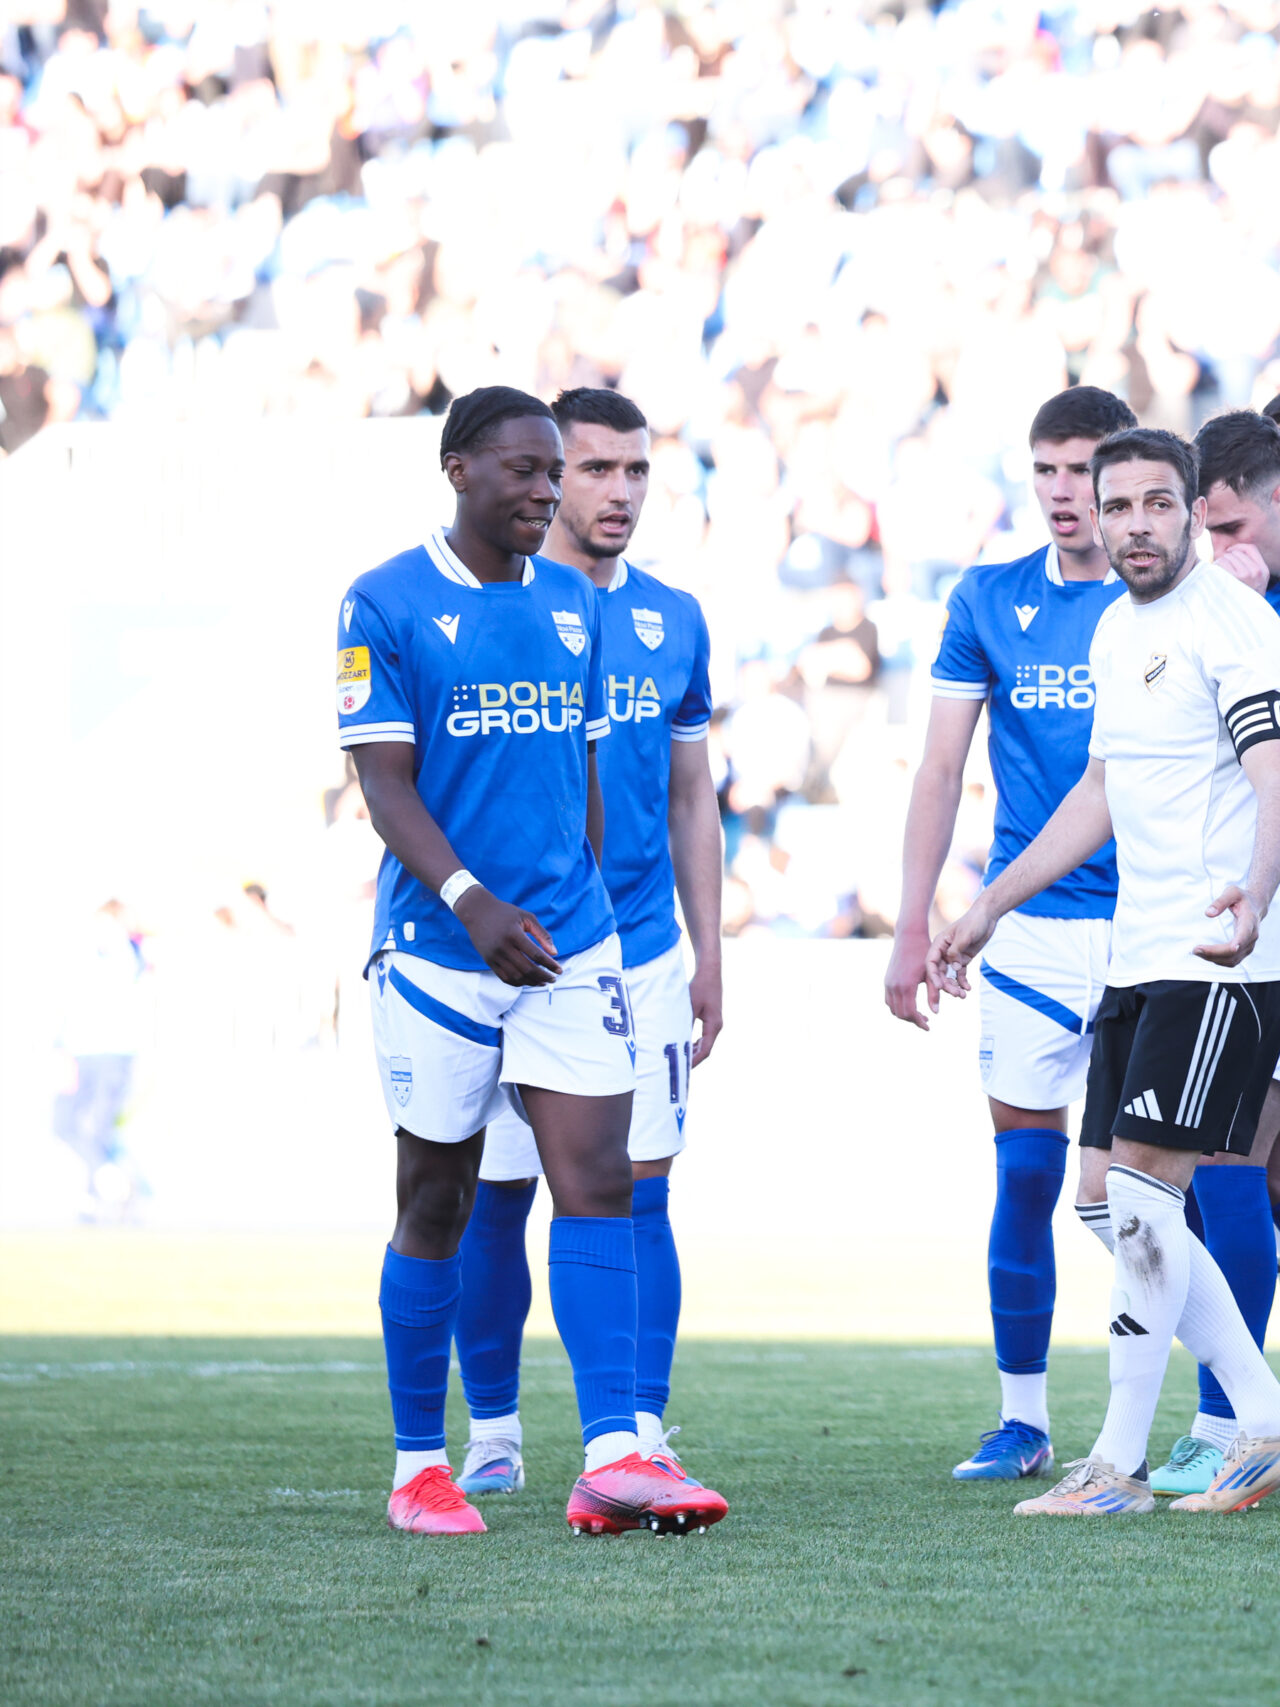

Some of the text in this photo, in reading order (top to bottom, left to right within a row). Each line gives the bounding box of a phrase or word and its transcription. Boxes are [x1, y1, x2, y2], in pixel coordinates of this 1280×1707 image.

[603, 674, 661, 700] HA
[1038, 664, 1095, 686] DO
[478, 681, 584, 708] DOHA
[1009, 686, 1096, 709] GRO
[446, 707, 583, 737] GROUP
